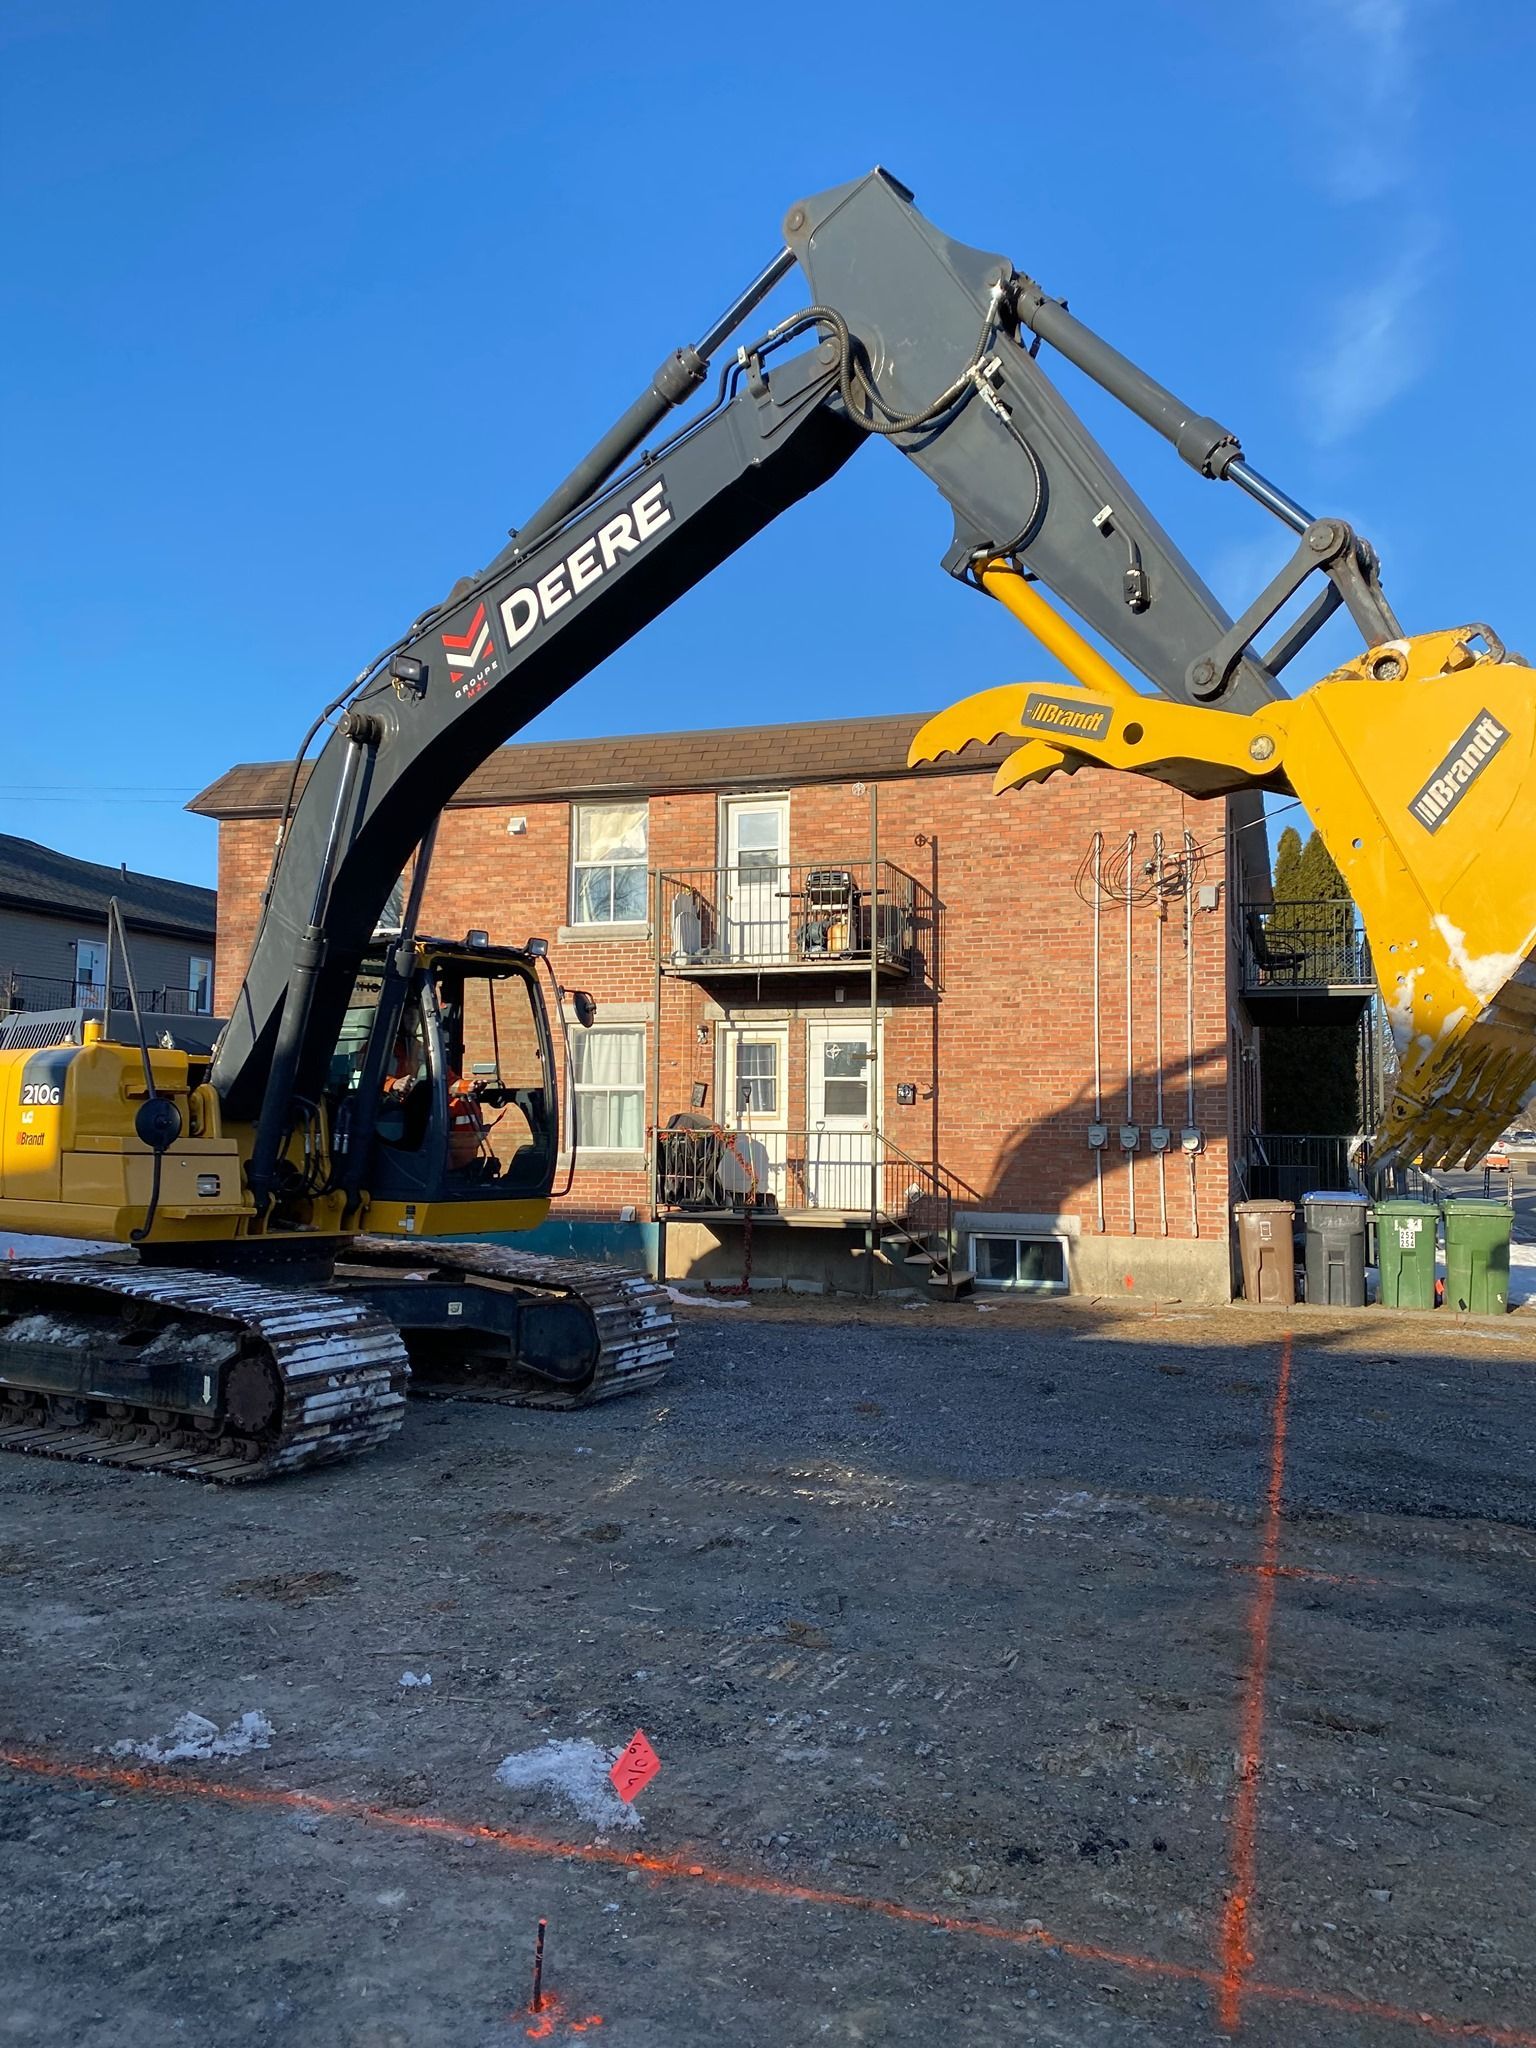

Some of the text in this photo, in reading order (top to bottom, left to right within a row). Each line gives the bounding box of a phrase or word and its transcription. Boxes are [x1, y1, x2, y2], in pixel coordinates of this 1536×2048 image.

[500, 480, 671, 648] DEERE
[455, 661, 498, 698] GROUPE
[1042, 704, 1105, 732] Brandt
[1427, 717, 1503, 808] Brandt
[23, 1084, 60, 1105] 210G
[20, 1132, 45, 1146] Brandt
[1400, 1231, 1414, 1239] 252
